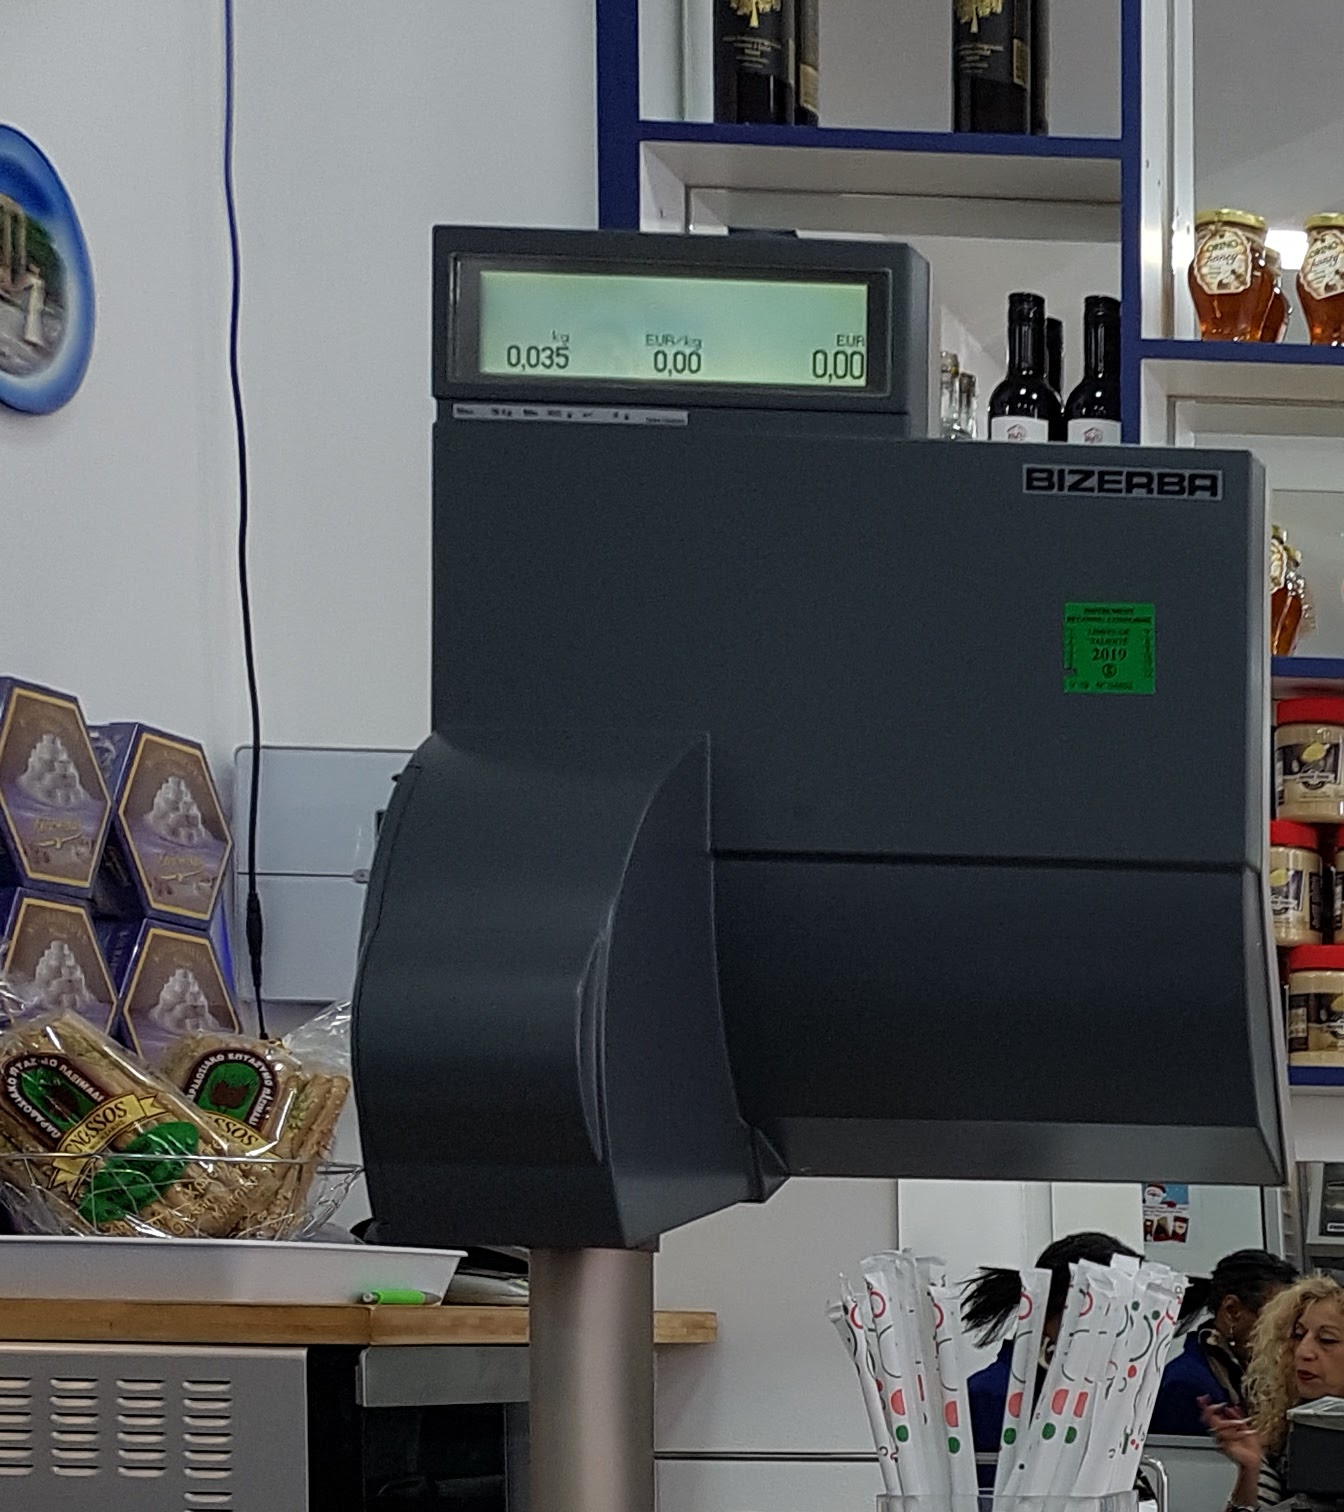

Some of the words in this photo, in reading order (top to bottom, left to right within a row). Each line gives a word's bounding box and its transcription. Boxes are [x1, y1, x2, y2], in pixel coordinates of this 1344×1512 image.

[837, 334, 864, 346] EUR
[507, 345, 569, 370] 0,035
[653, 350, 701, 376] 0,00
[812, 350, 864, 382] 0,00
[1025, 467, 1220, 497] BIZERBA
[1092, 648, 1127, 660] 2019
